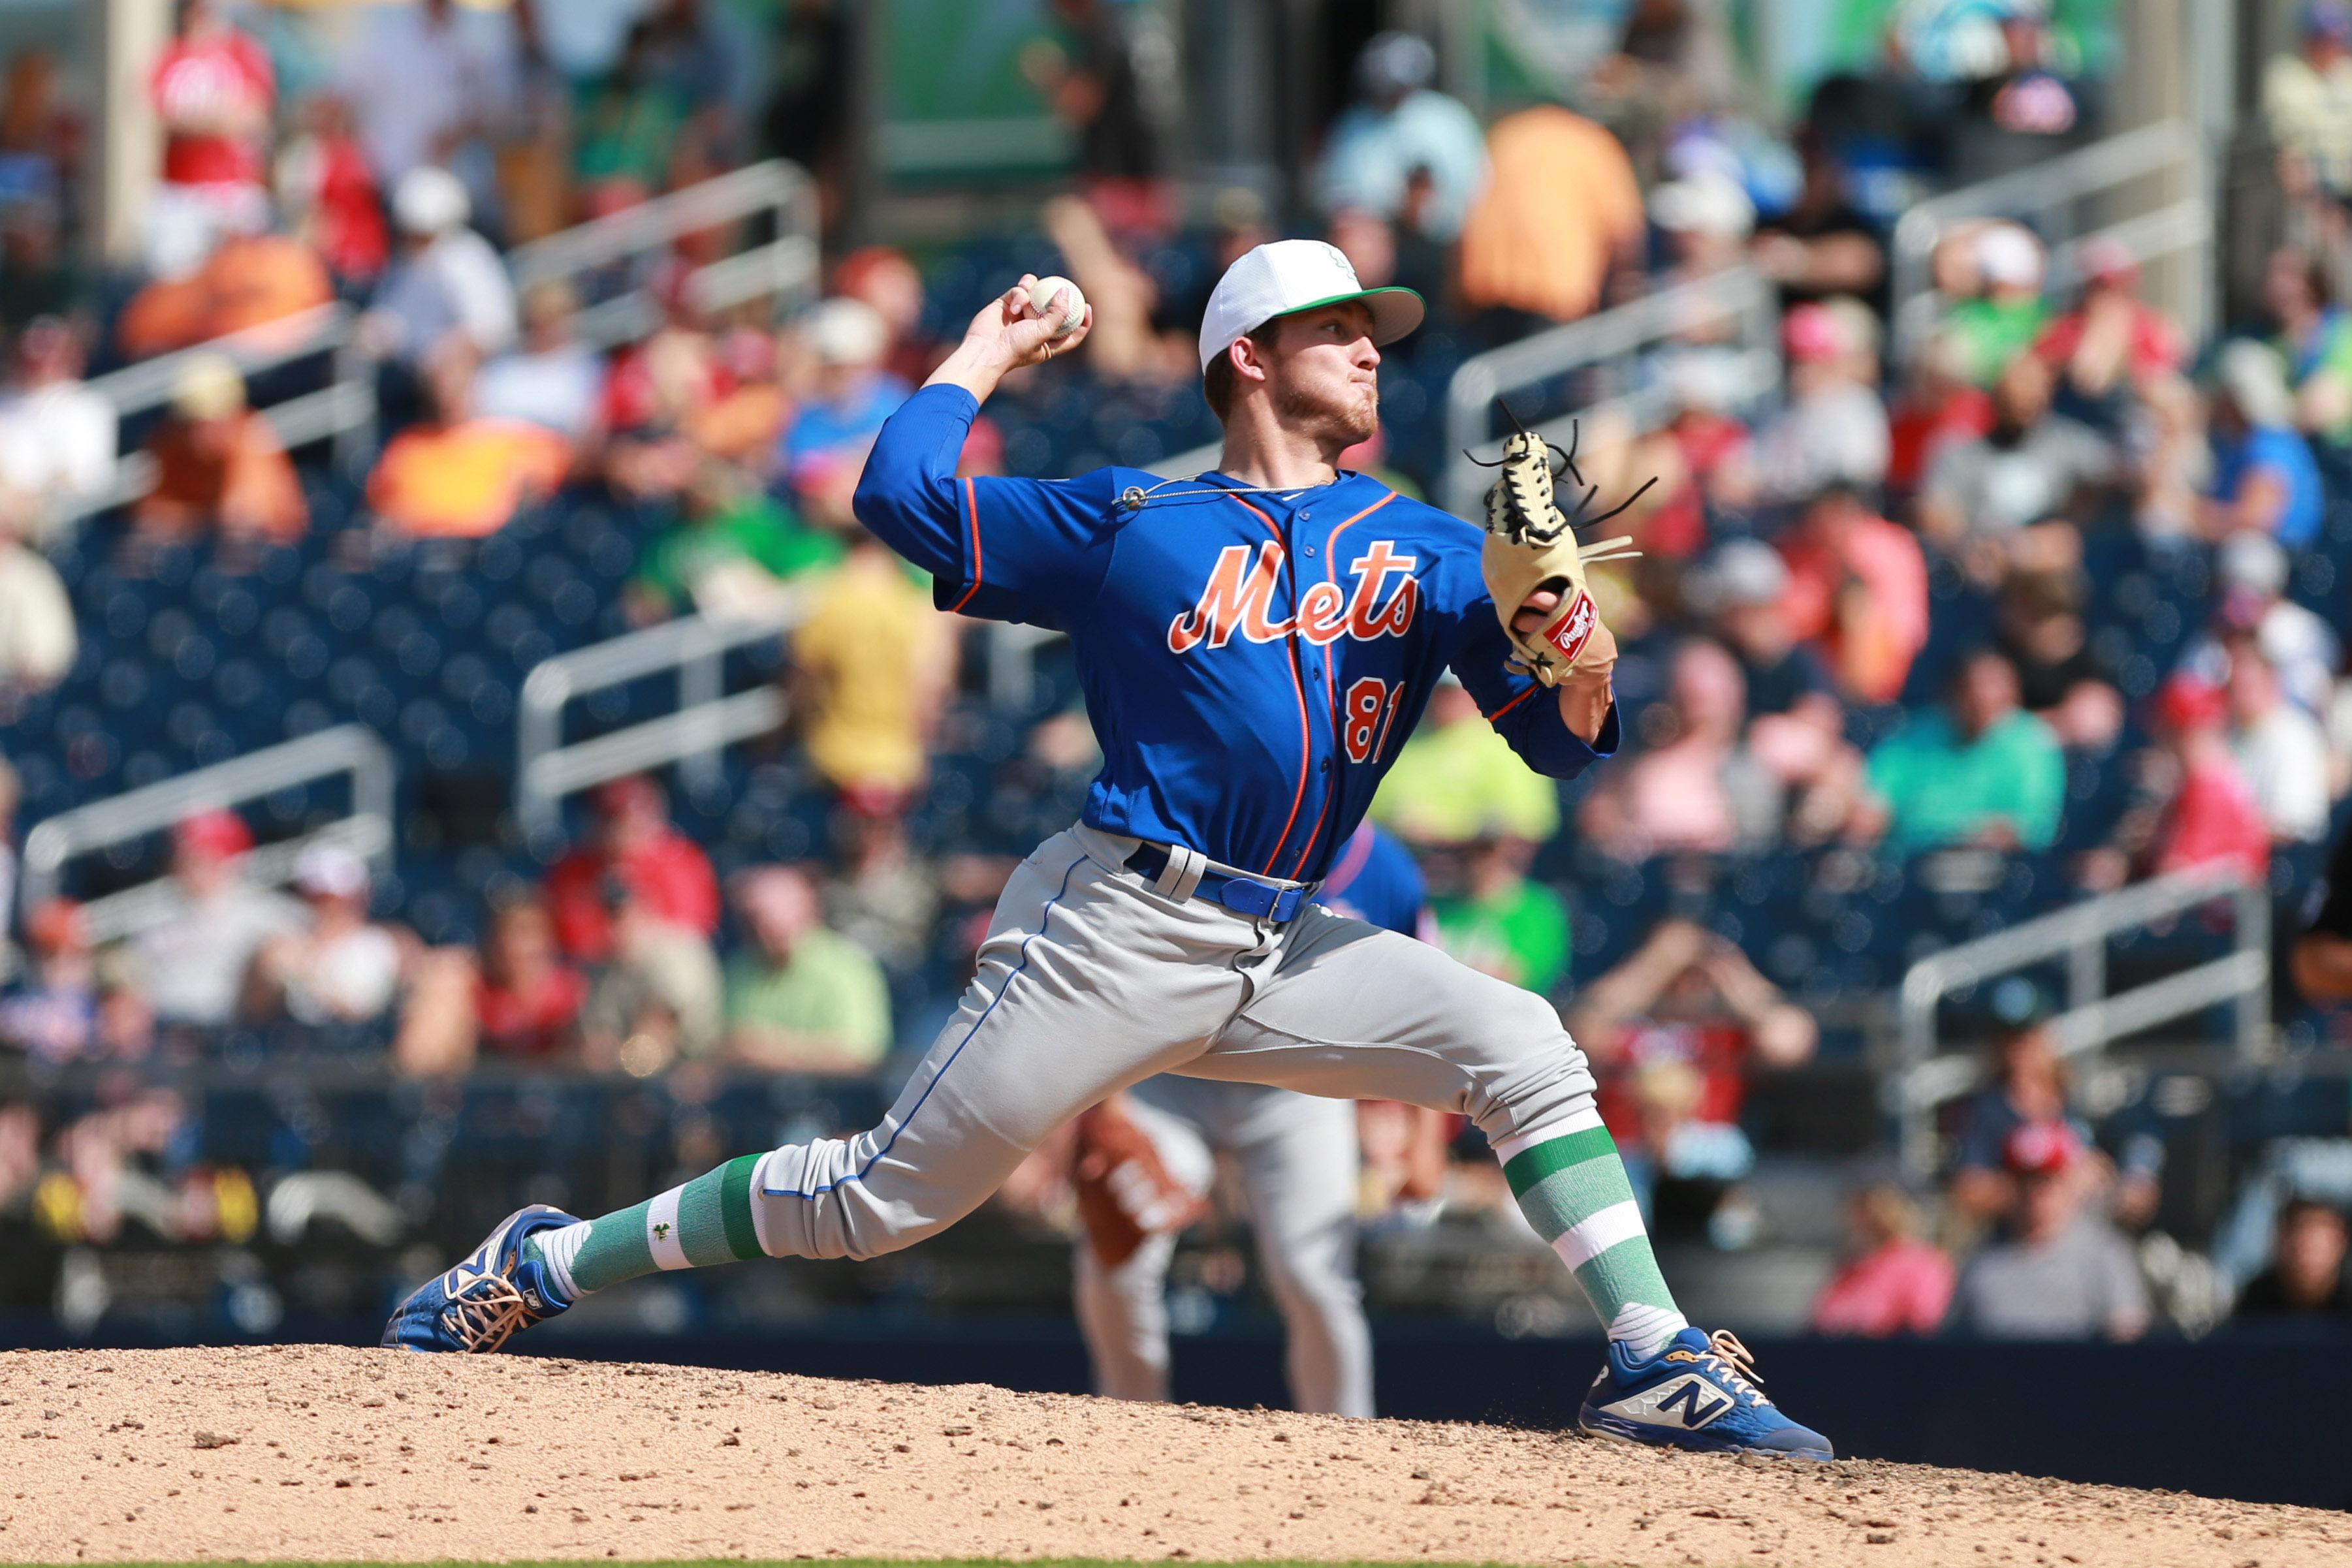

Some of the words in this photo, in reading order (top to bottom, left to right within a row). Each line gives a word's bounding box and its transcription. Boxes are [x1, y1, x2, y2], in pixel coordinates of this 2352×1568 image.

[1168, 540, 1420, 654] Mets
[1345, 676, 1405, 764] 81
[1657, 1381, 1727, 1428] N
